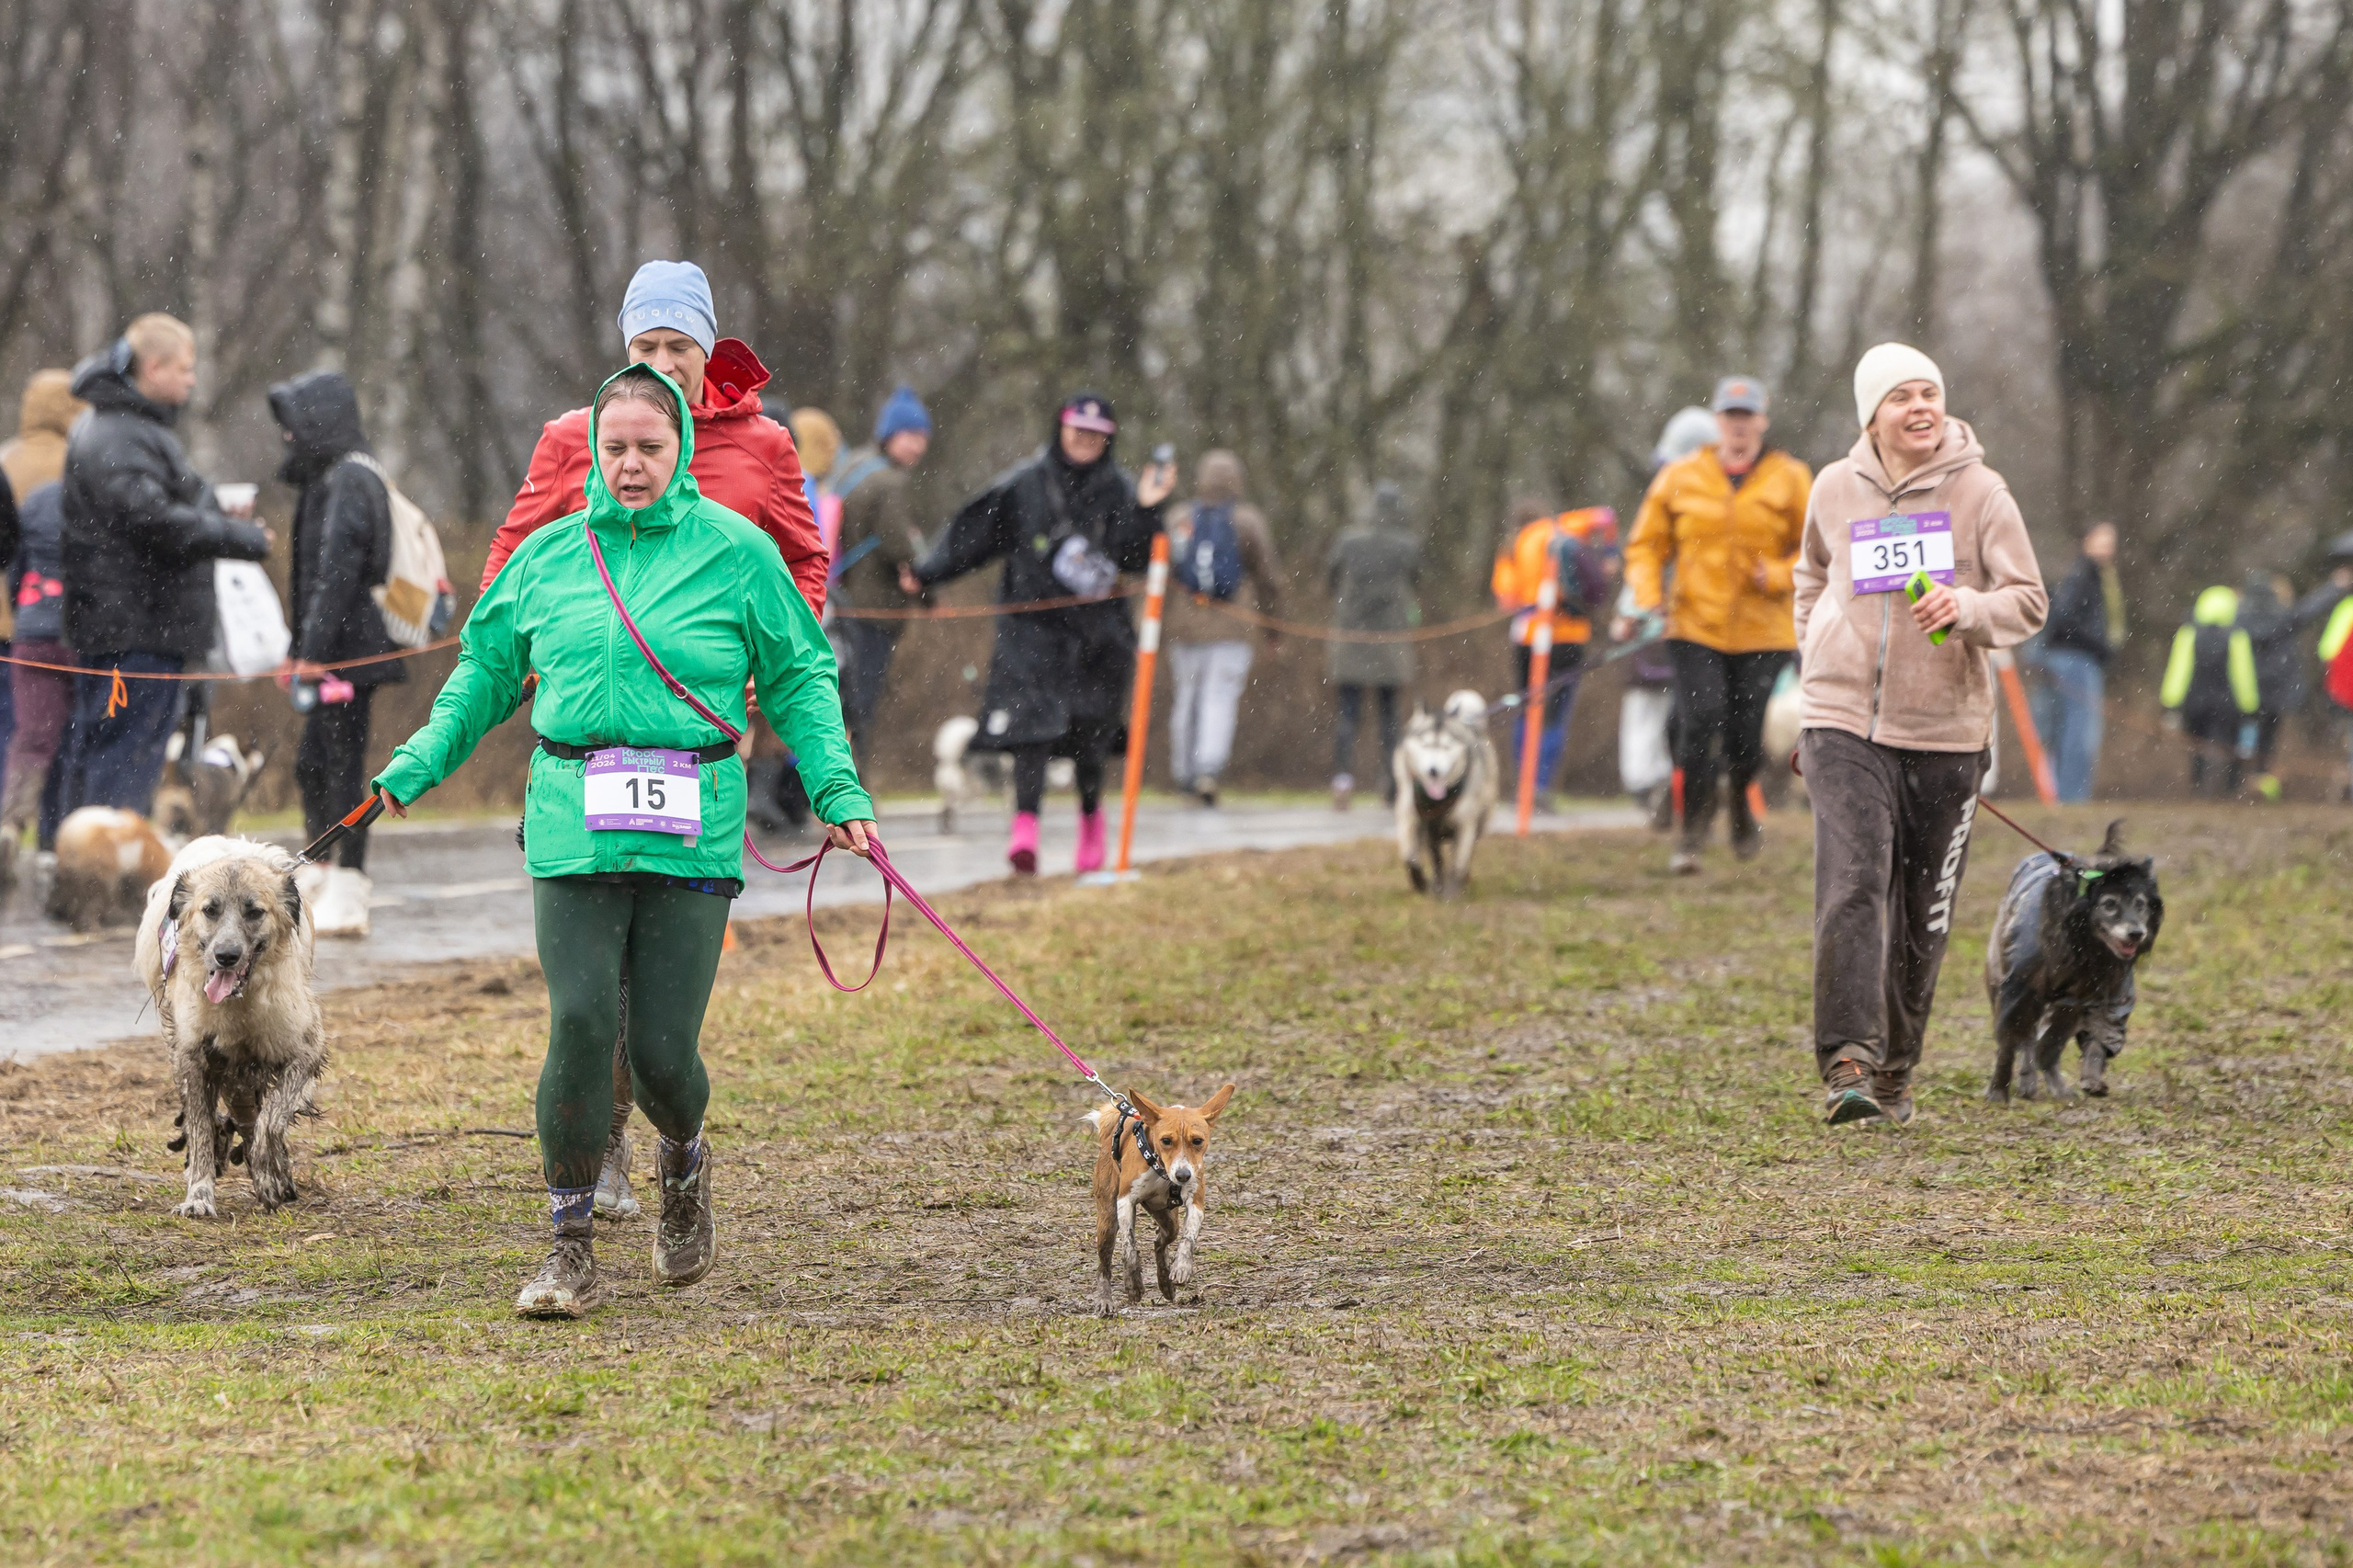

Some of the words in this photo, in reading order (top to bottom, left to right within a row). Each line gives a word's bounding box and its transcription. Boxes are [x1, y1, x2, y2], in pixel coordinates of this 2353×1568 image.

[1874, 540, 1925, 570] 351
[590, 760, 616, 769] 2026
[621, 749, 656, 758] КРОСС
[626, 778, 665, 811] 15
[1927, 793, 1977, 935] PROFIT
